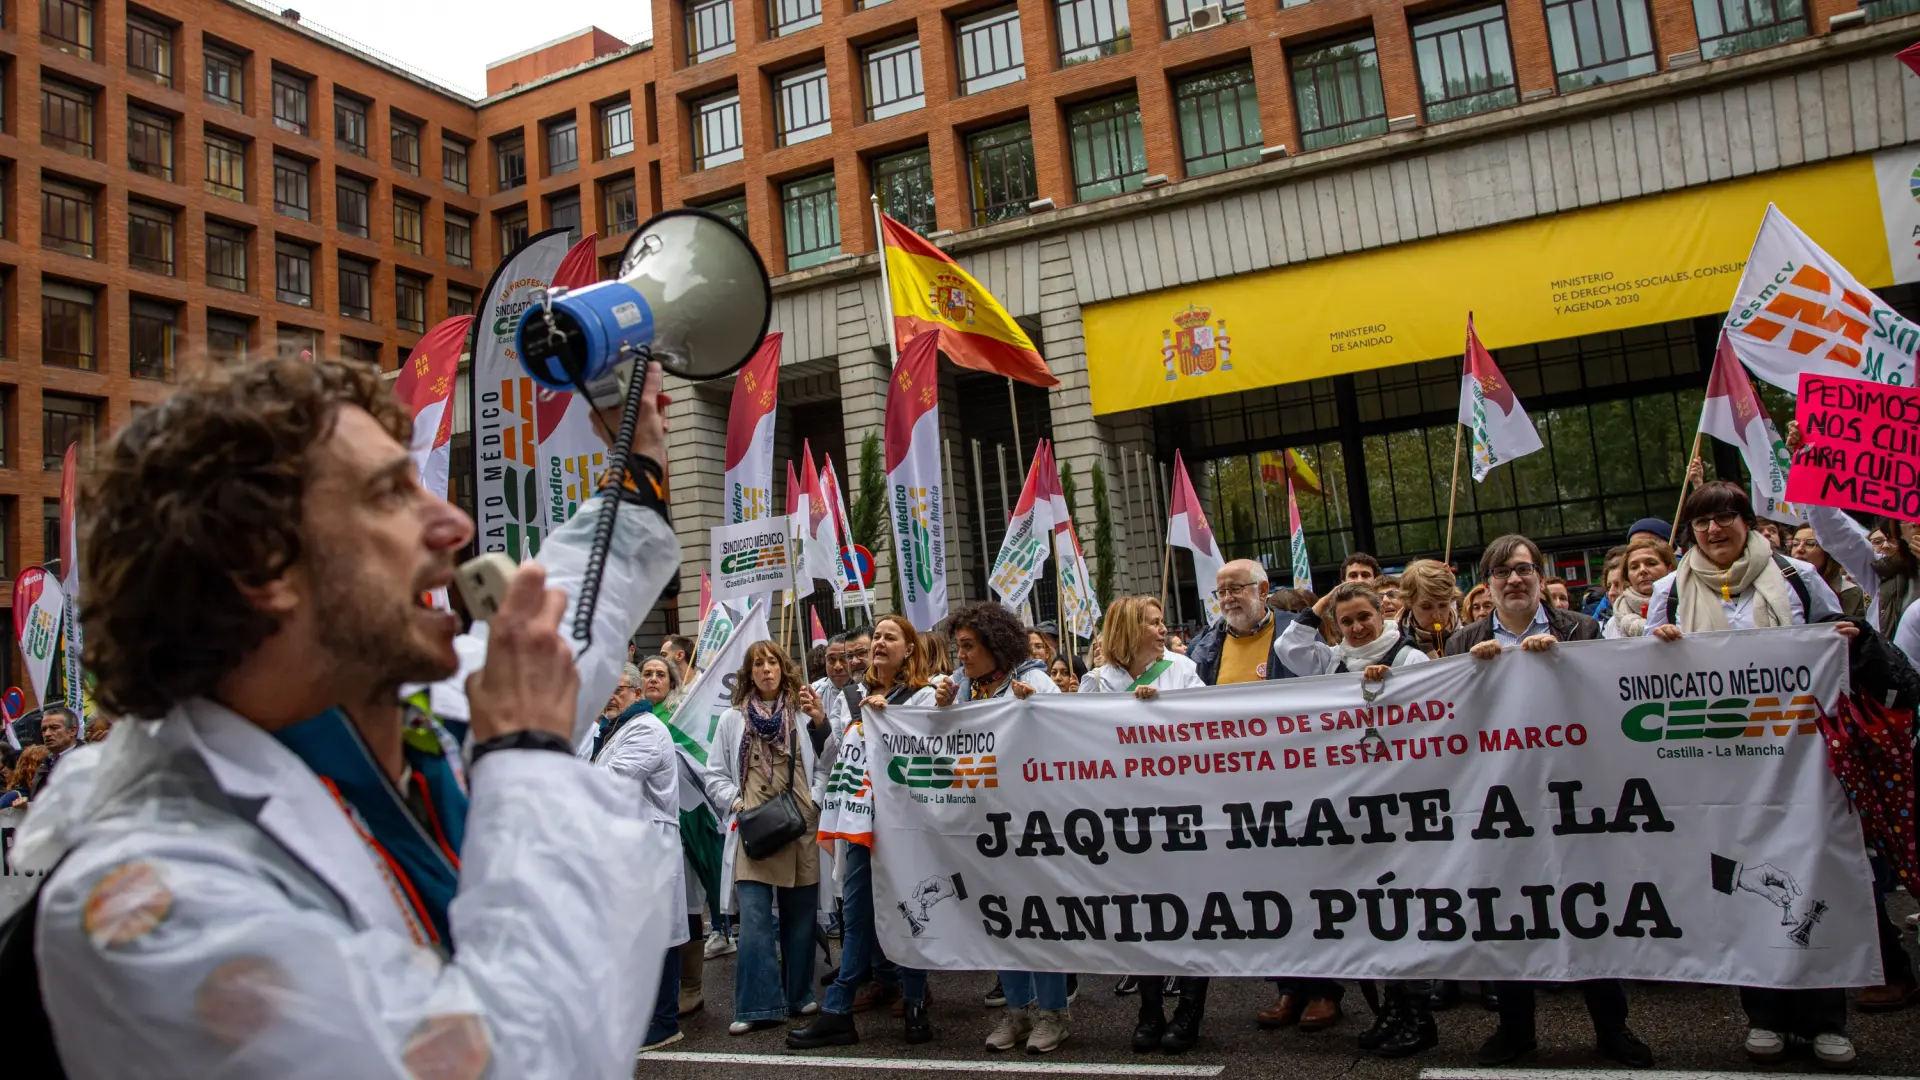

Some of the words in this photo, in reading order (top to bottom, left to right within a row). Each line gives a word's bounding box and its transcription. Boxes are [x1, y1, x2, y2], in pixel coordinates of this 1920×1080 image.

[1551, 271, 1614, 290] MINISTERIO
[1553, 293, 1568, 303] DE
[1571, 281, 1632, 299] DERECHOS
[1635, 271, 1692, 289] SOCIALES,
[1730, 260, 1795, 328] cesmcv
[1554, 306, 1561, 316] Y
[1564, 299, 1612, 314] AGENDA
[1615, 294, 1640, 306] 2030
[1330, 323, 1386, 341] MINISTERIO
[1332, 343, 1344, 353] DE
[1348, 335, 1393, 350] SANIDAD
[480, 391, 503, 482] MÉDICO
[1807, 410, 1862, 443] NOS
[1794, 443, 1846, 471] PARA
[550, 455, 565, 523] Médico
[930, 485, 939, 523] Murcia
[895, 485, 909, 535] Médico
[722, 537, 754, 554] SINDICATO
[755, 531, 784, 548] MÉDICO
[933, 523, 940, 538] de
[721, 545, 786, 574] CESM
[930, 538, 944, 576] Región
[23, 572, 43, 587] Murcia
[756, 571, 783, 581] Mancha
[66, 593, 75, 642] Médico
[26, 624, 36, 656] Sindicato
[65, 646, 77, 709] Sindicato
[1618, 670, 1724, 702] SINDICATO
[1728, 661, 1811, 696] MÉDICO
[1116, 717, 1268, 745] MINISTERIO
[1276, 713, 1312, 736] DE
[1319, 699, 1455, 731] SANIDAD:
[1620, 695, 1818, 742] CESM
[882, 733, 943, 755] SINDICATO
[946, 729, 995, 755] MÉDICO
[1022, 757, 1118, 783] ÚLTIMA
[1124, 749, 1276, 778] PROPUESTA
[1284, 748, 1317, 770] DE
[1325, 733, 1468, 766] ESTATUTO
[1478, 723, 1587, 753] MARCO
[1656, 745, 1705, 759] Castilla
[1715, 744, 1732, 758] La
[1735, 743, 1785, 758] Mancha
[887, 755, 998, 789] CESM
[935, 795, 945, 804] La
[946, 794, 976, 804] Mancha
[976, 804, 1208, 865] JAQUE
[1222, 788, 1454, 849] MATE
[1471, 784, 1534, 841] A
[1548, 777, 1675, 835] LA
[978, 889, 1293, 943] SANIDAD
[1309, 870, 1683, 942] PÚBLICA
